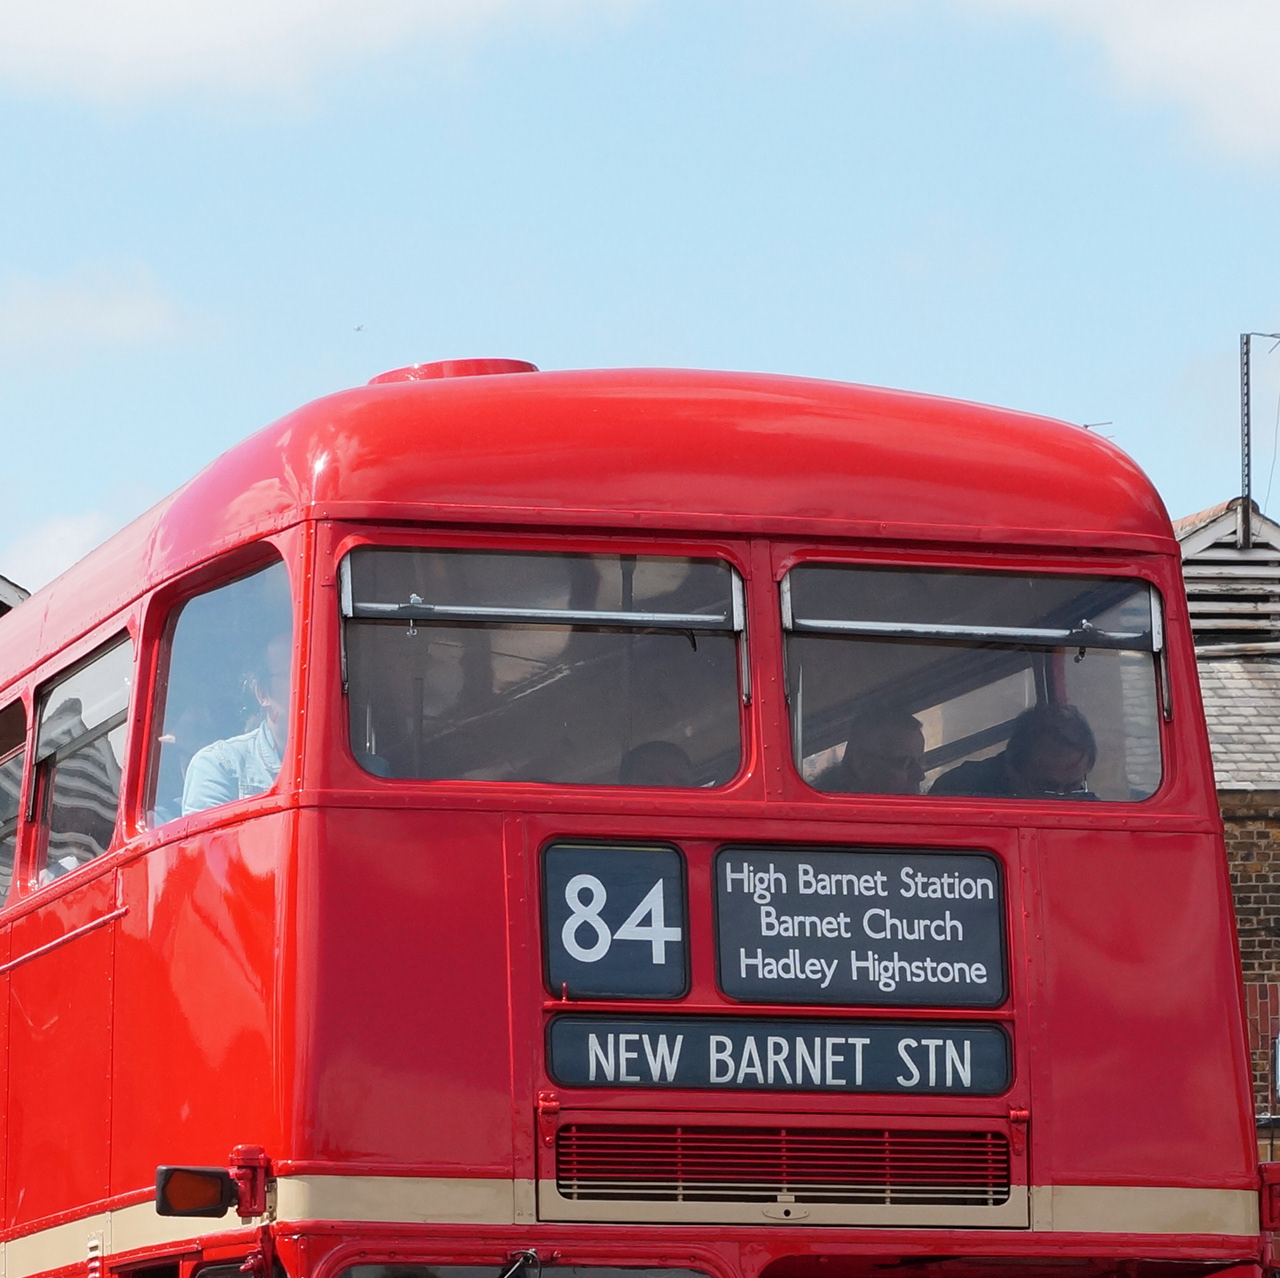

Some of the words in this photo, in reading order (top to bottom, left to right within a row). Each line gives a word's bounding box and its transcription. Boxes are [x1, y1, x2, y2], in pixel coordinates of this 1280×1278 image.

[725, 862, 787, 903] High
[797, 863, 888, 897] Barnet
[899, 866, 995, 900] Station
[561, 873, 682, 965] 84
[760, 906, 851, 938] Barnet
[862, 908, 964, 941] Church
[739, 947, 839, 988] Hadley
[850, 950, 988, 992] Highstone
[588, 1033, 684, 1082] NEW
[709, 1034, 871, 1086] BARNET
[896, 1037, 972, 1088] STN
